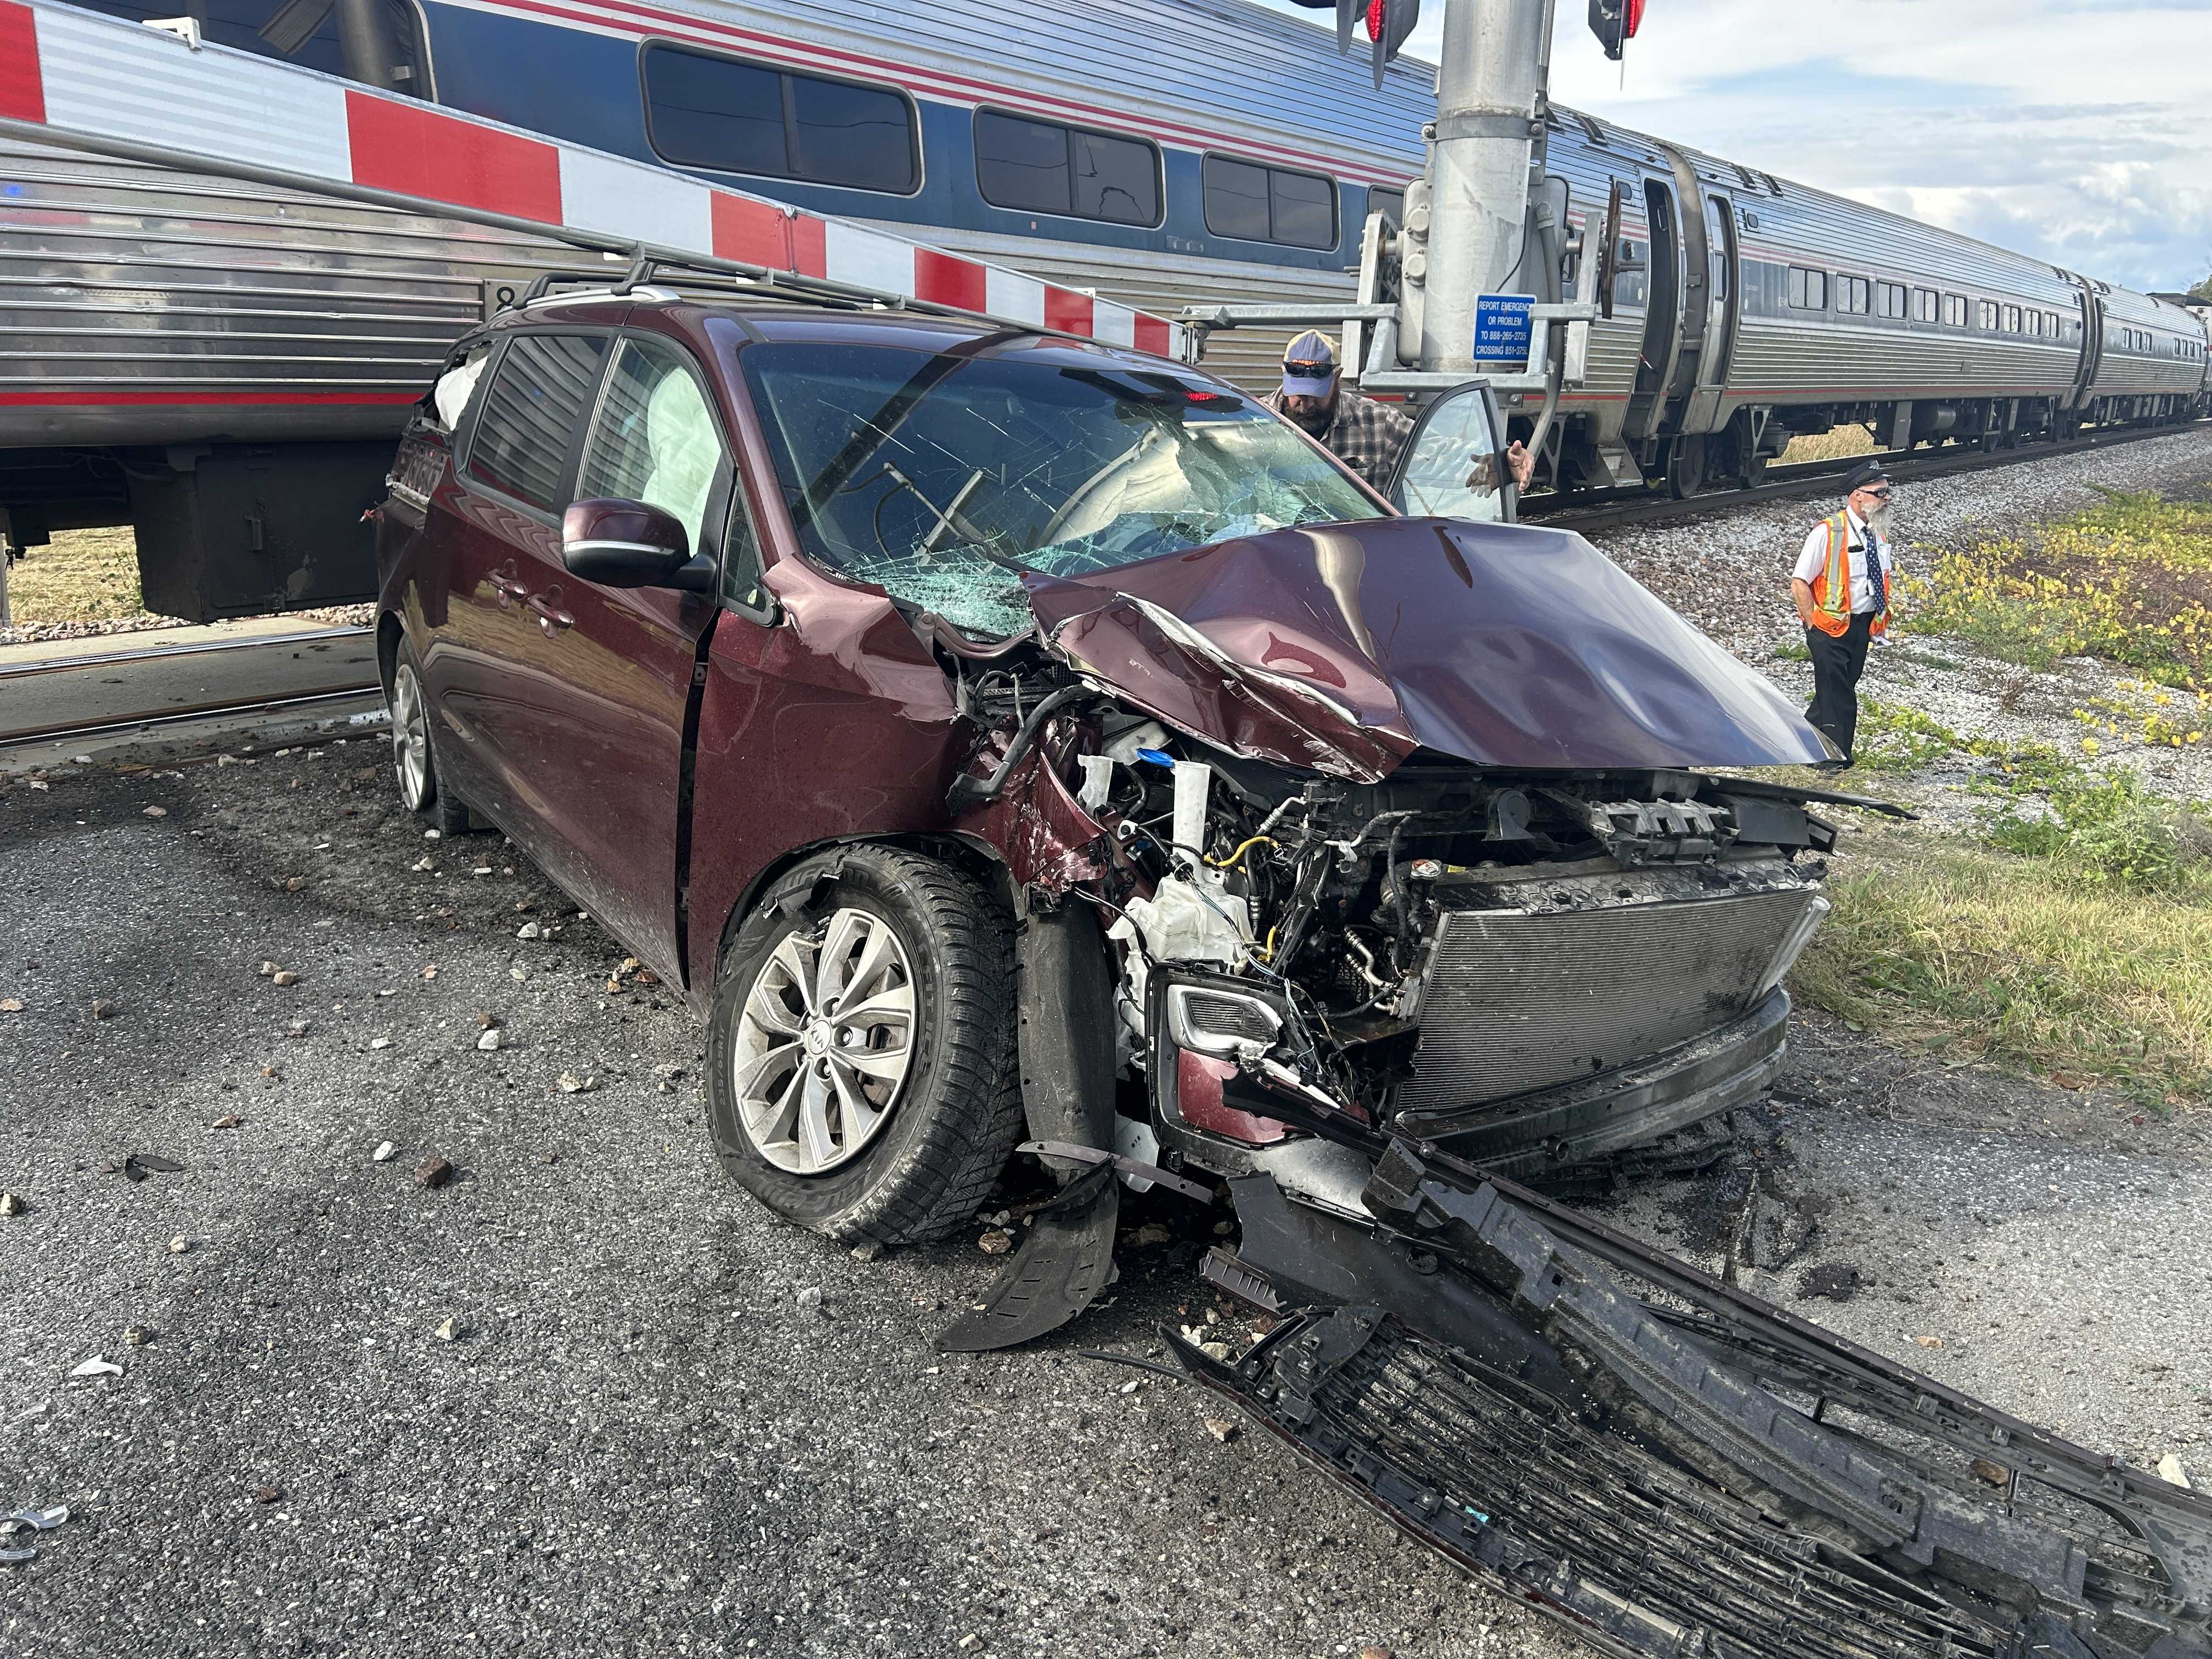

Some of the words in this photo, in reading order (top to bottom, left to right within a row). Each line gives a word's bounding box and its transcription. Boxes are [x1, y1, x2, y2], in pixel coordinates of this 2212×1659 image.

[1479, 301, 1499, 311] REPORT
[1501, 302, 1531, 312] EMERGENC
[1488, 316, 1496, 325] OR
[1498, 317, 1522, 325] PROBLEM
[1481, 331, 1488, 340] TO
[1489, 331, 1527, 341] 888-265-2735
[1476, 345, 1503, 355] CROSSING
[810, 1026, 824, 1049] KIA
[717, 1022, 726, 1106] 235/65R17
